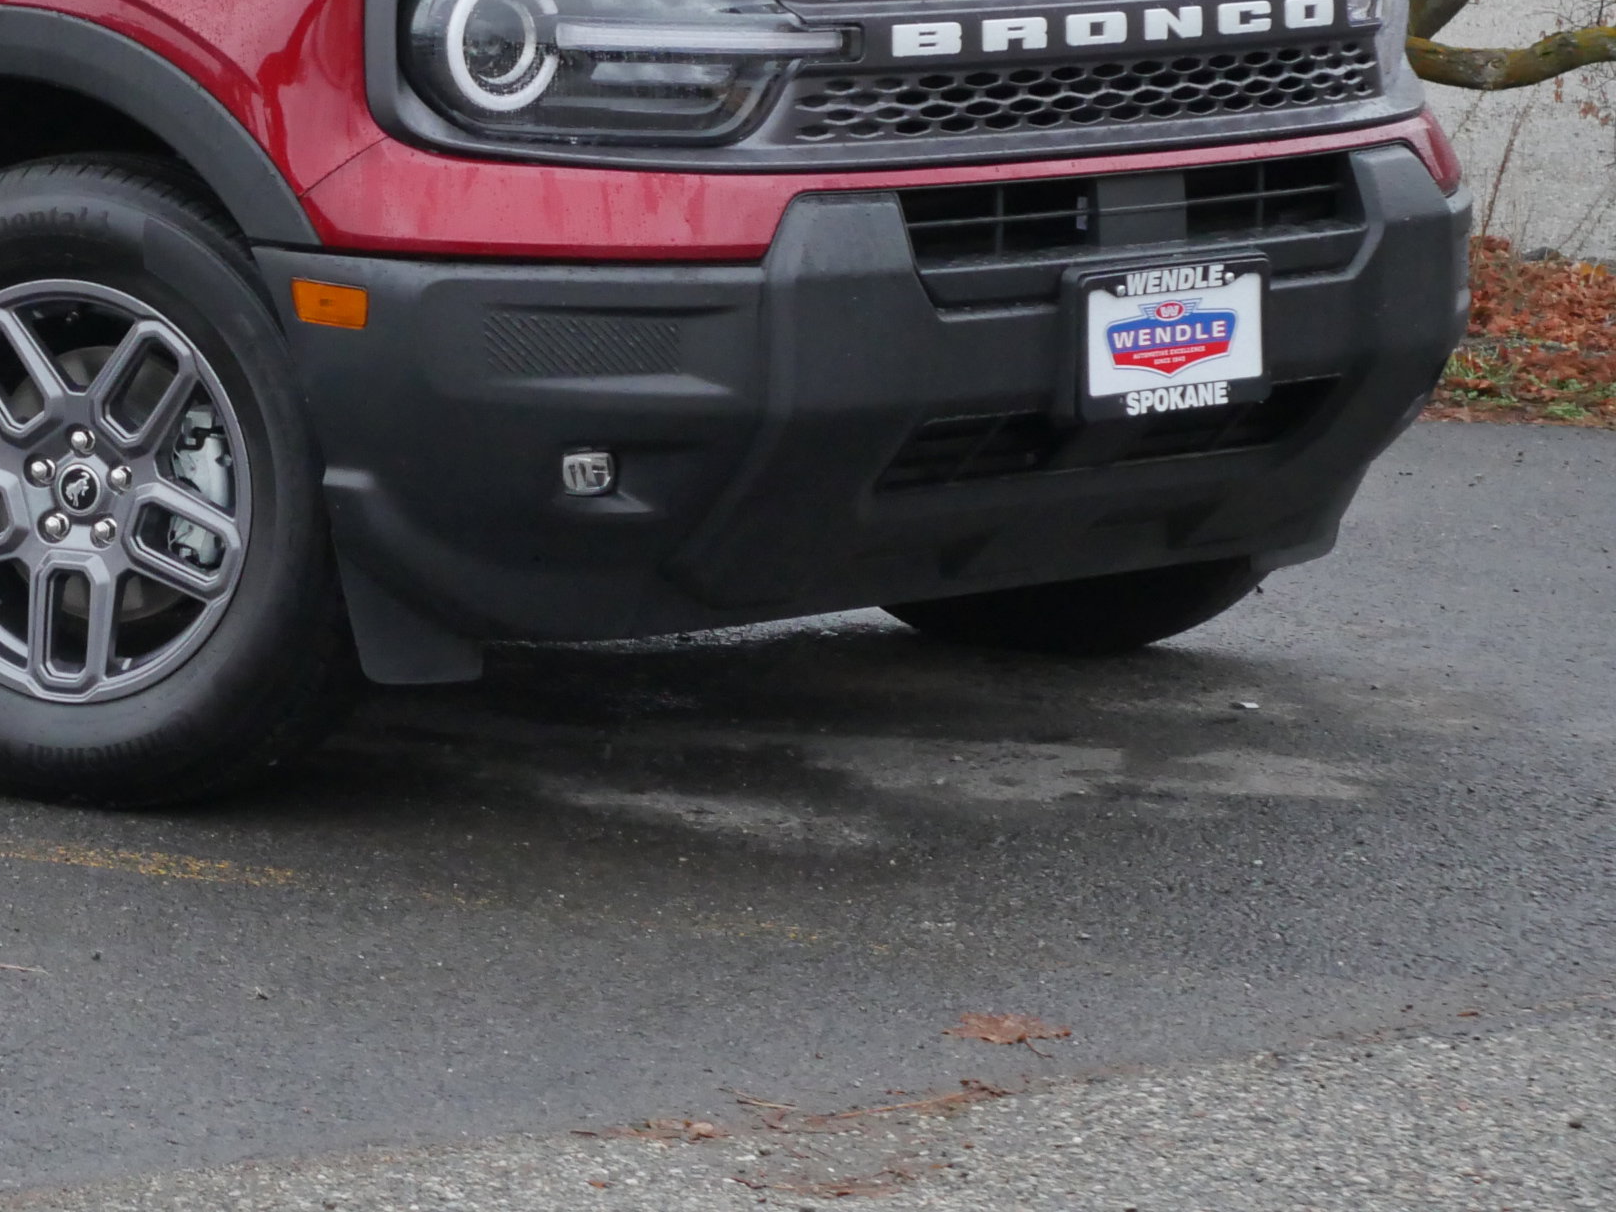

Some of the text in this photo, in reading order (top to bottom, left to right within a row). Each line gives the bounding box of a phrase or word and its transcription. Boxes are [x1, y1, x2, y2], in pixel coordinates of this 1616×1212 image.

[1125, 264, 1225, 295] WENDLE
[1112, 320, 1227, 349] WENDLE
[1125, 381, 1229, 416] SPOKANE
